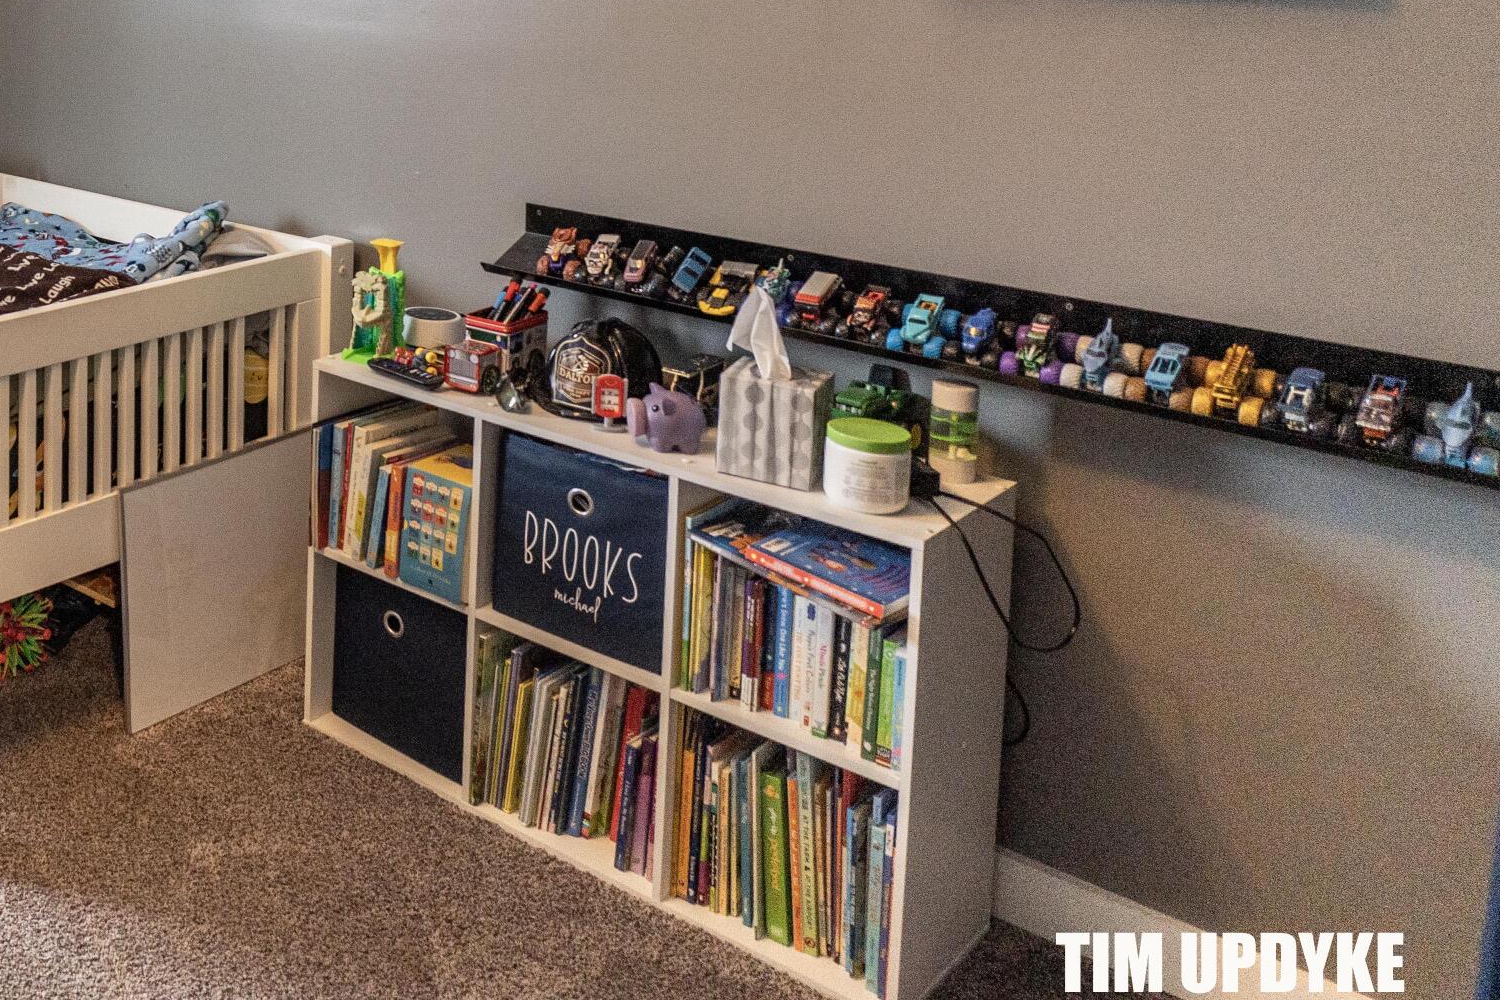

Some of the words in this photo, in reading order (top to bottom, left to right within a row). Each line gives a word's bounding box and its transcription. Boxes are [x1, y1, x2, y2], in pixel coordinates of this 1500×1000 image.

[38, 275, 76, 304] Laugh
[524, 510, 643, 604] BROOKS
[553, 586, 602, 625] michael
